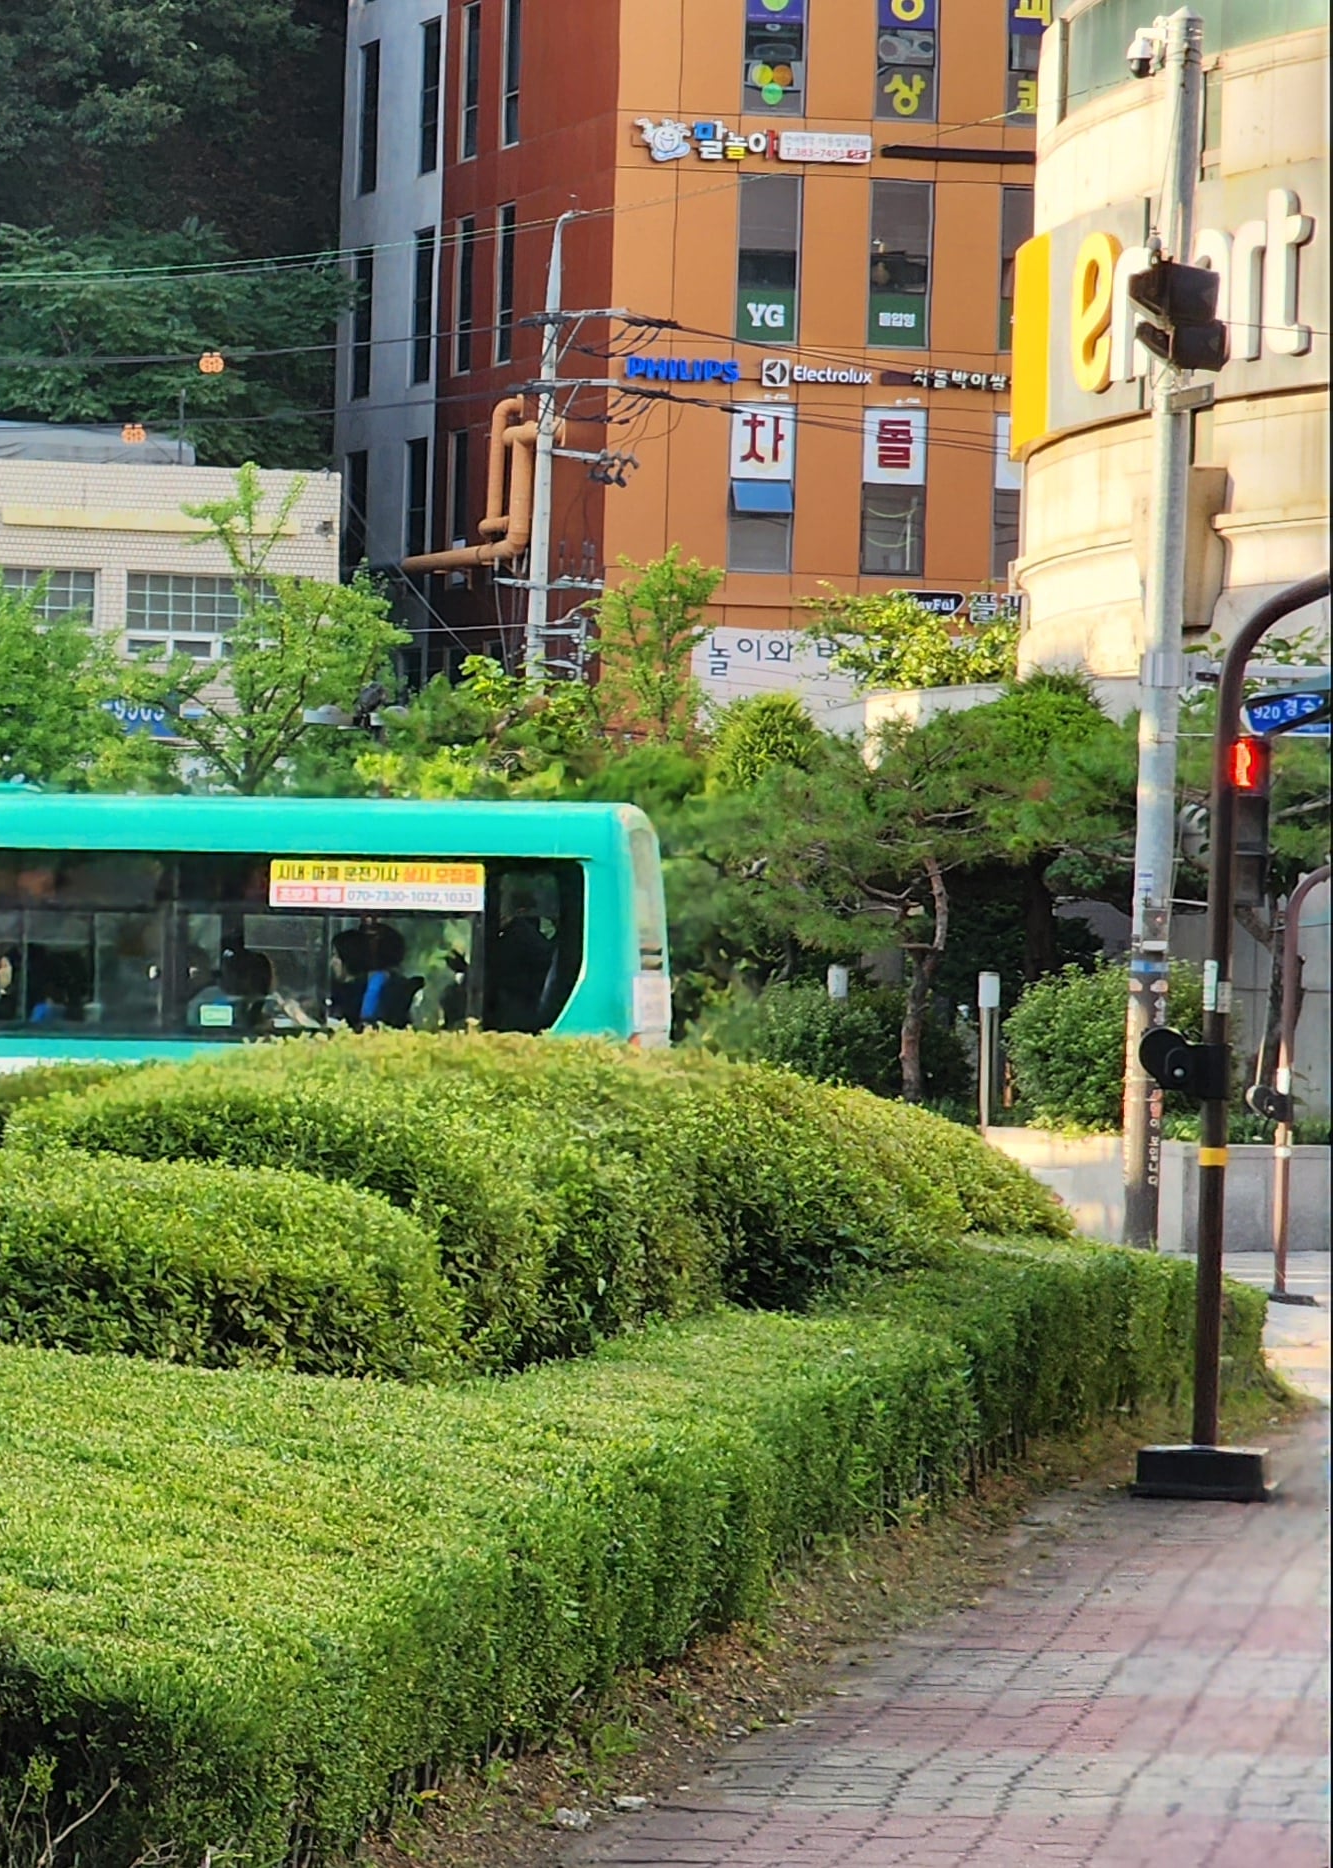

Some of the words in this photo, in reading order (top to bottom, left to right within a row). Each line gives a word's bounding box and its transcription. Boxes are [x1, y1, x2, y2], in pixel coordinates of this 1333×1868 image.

[746, 303, 785, 327] YG
[625, 356, 740, 384] PHILIPS
[793, 364, 873, 385] Electrolux
[740, 410, 785, 464] 차
[876, 418, 913, 470] 돌
[707, 637, 793, 677] 놀이와
[343, 866, 399, 882] 운전기사
